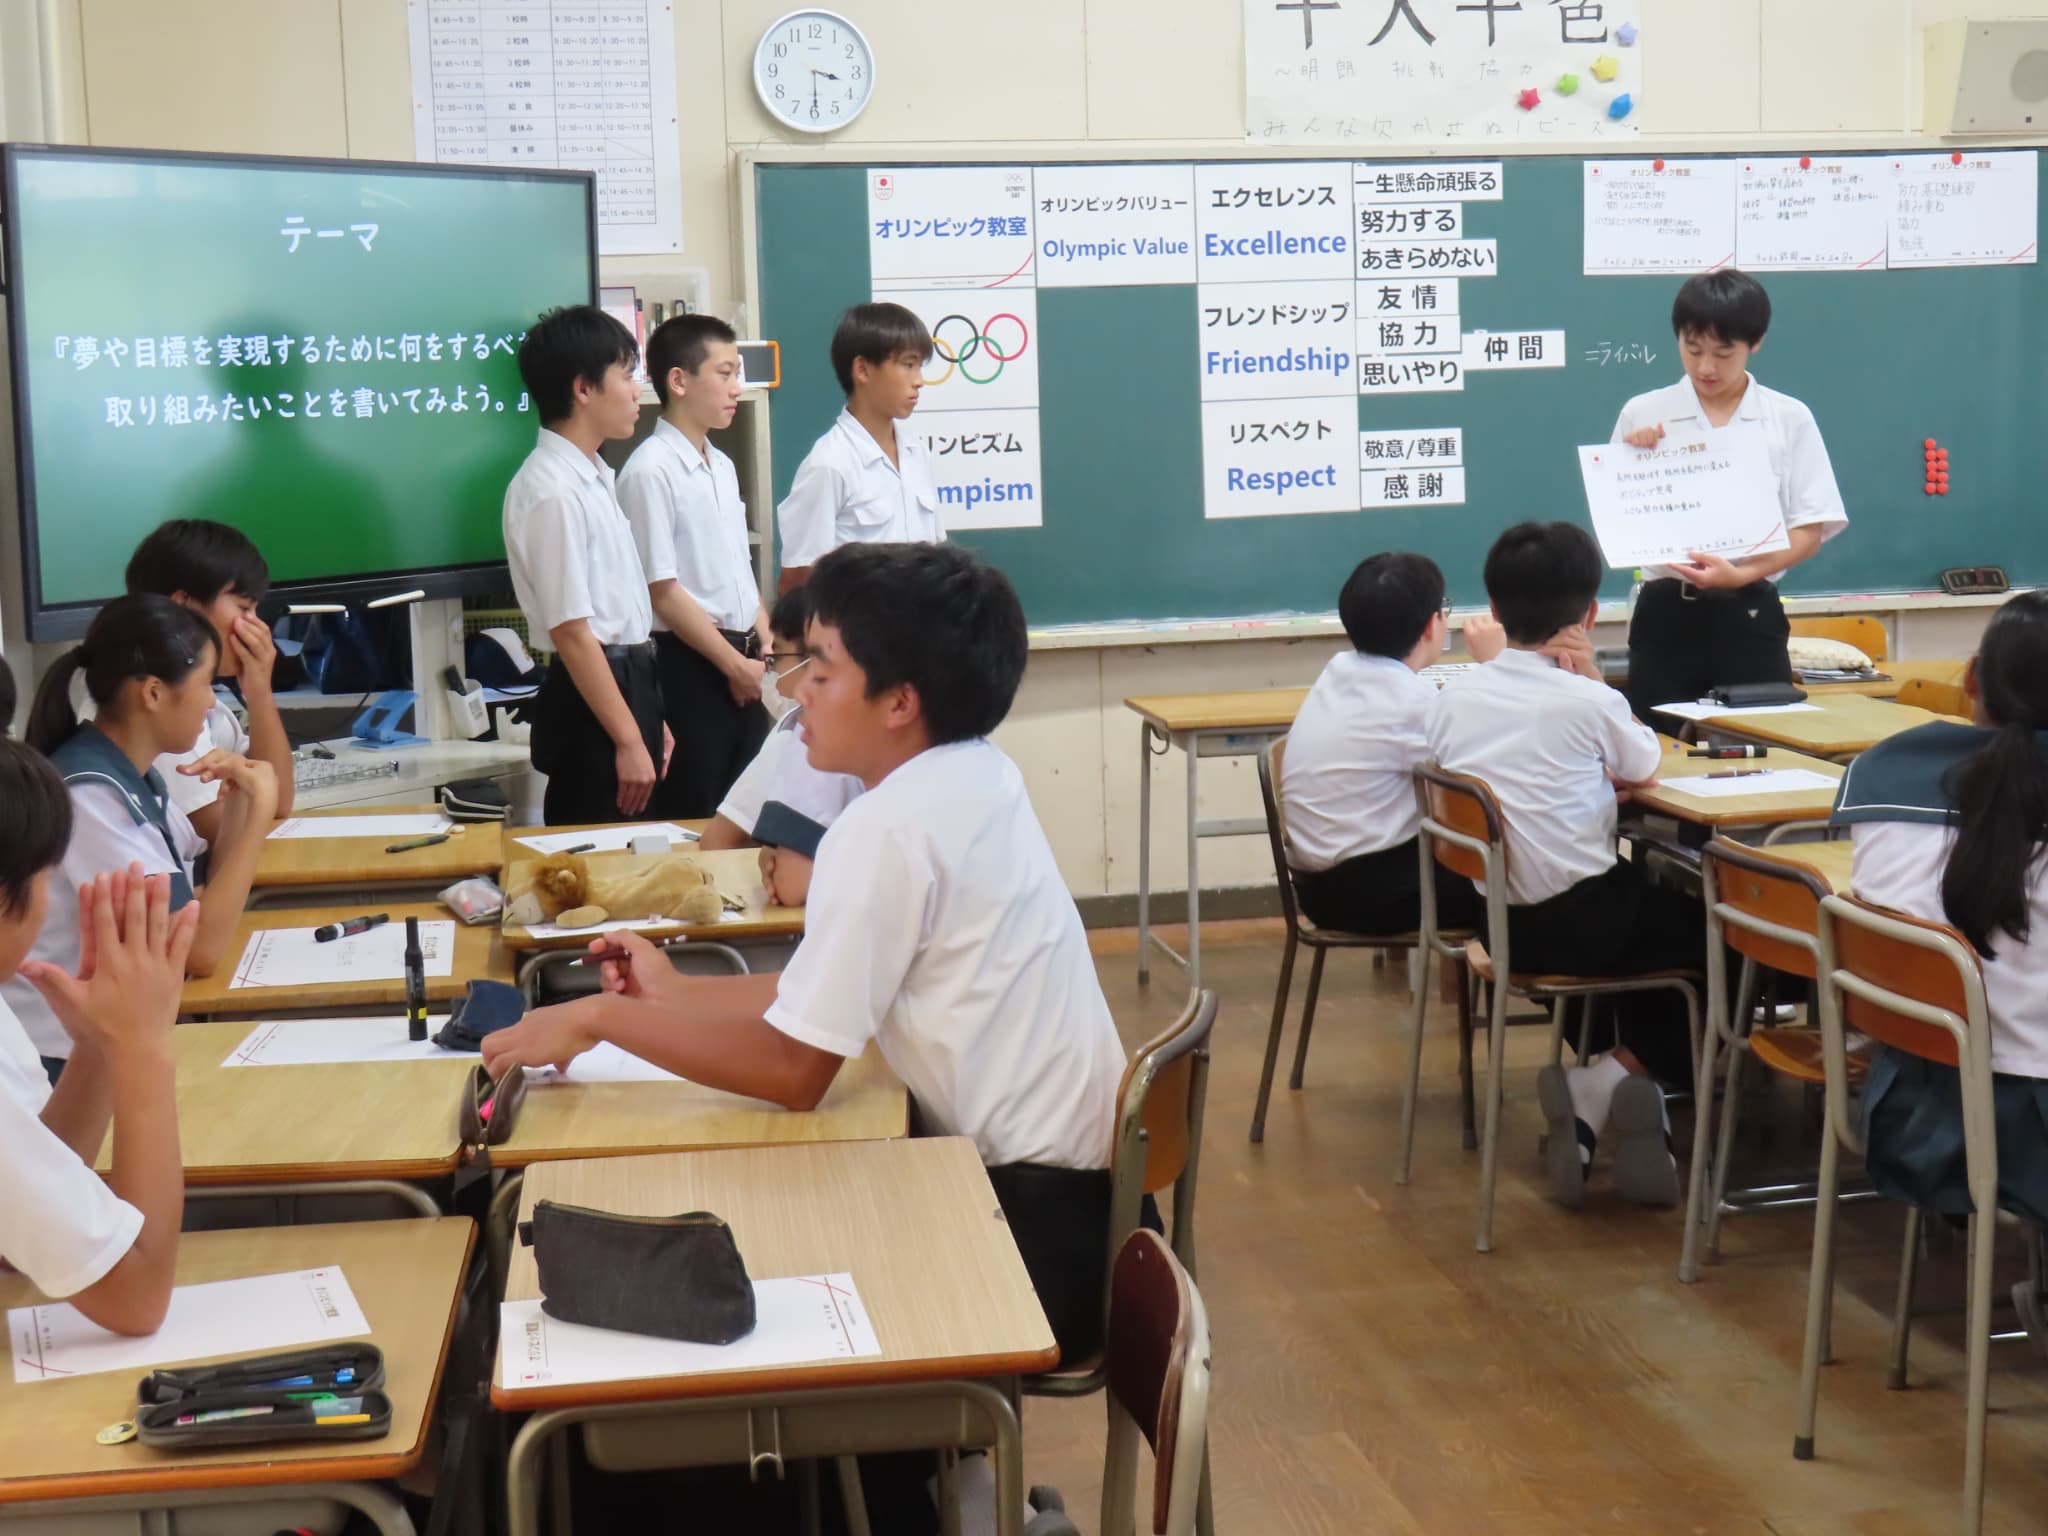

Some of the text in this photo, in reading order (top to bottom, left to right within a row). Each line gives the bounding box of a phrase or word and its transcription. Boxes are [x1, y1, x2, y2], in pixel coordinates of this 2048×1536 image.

[789, 28, 801, 43] 11
[807, 23, 822, 39] 12
[832, 29, 837, 44] 1
[773, 42, 787, 58] 10
[844, 43, 854, 59] 2
[768, 62, 778, 79] 9
[850, 64, 861, 80] 3
[775, 83, 785, 99] 8
[845, 87, 853, 100] 4
[791, 99, 801, 114] 7
[809, 104, 820, 119] 6
[830, 100, 840, 115] 5
[1354, 171, 1497, 195] 一生懸命頑張る
[1041, 196, 1188, 213] オリンピックバリュー
[1211, 186, 1336, 208] エクセレンス
[875, 215, 1028, 239] オリンピック教室
[1360, 208, 1456, 234] 努力する
[279, 213, 380, 254] テーマ
[1204, 230, 1347, 257] Excellence
[1042, 236, 1189, 262] Olympic Value
[1361, 247, 1495, 271] あきらめない
[1377, 284, 1437, 310] 友情
[1204, 302, 1350, 328] フレンドシップ
[1378, 321, 1437, 348] 協力
[54, 331, 528, 371] 『夢や目標を実現するために何をするべ
[1207, 346, 1350, 377] Friendship
[1483, 336, 1544, 363] 仲間
[1362, 362, 1459, 387] 思いやり
[105, 384, 529, 429] 取り組みたいことを書いてみよう。』
[1230, 419, 1332, 445] リスペクト
[1364, 438, 1457, 460] 敬意/尊重
[1227, 464, 1337, 496] Respect
[1383, 472, 1444, 500] 感謝
